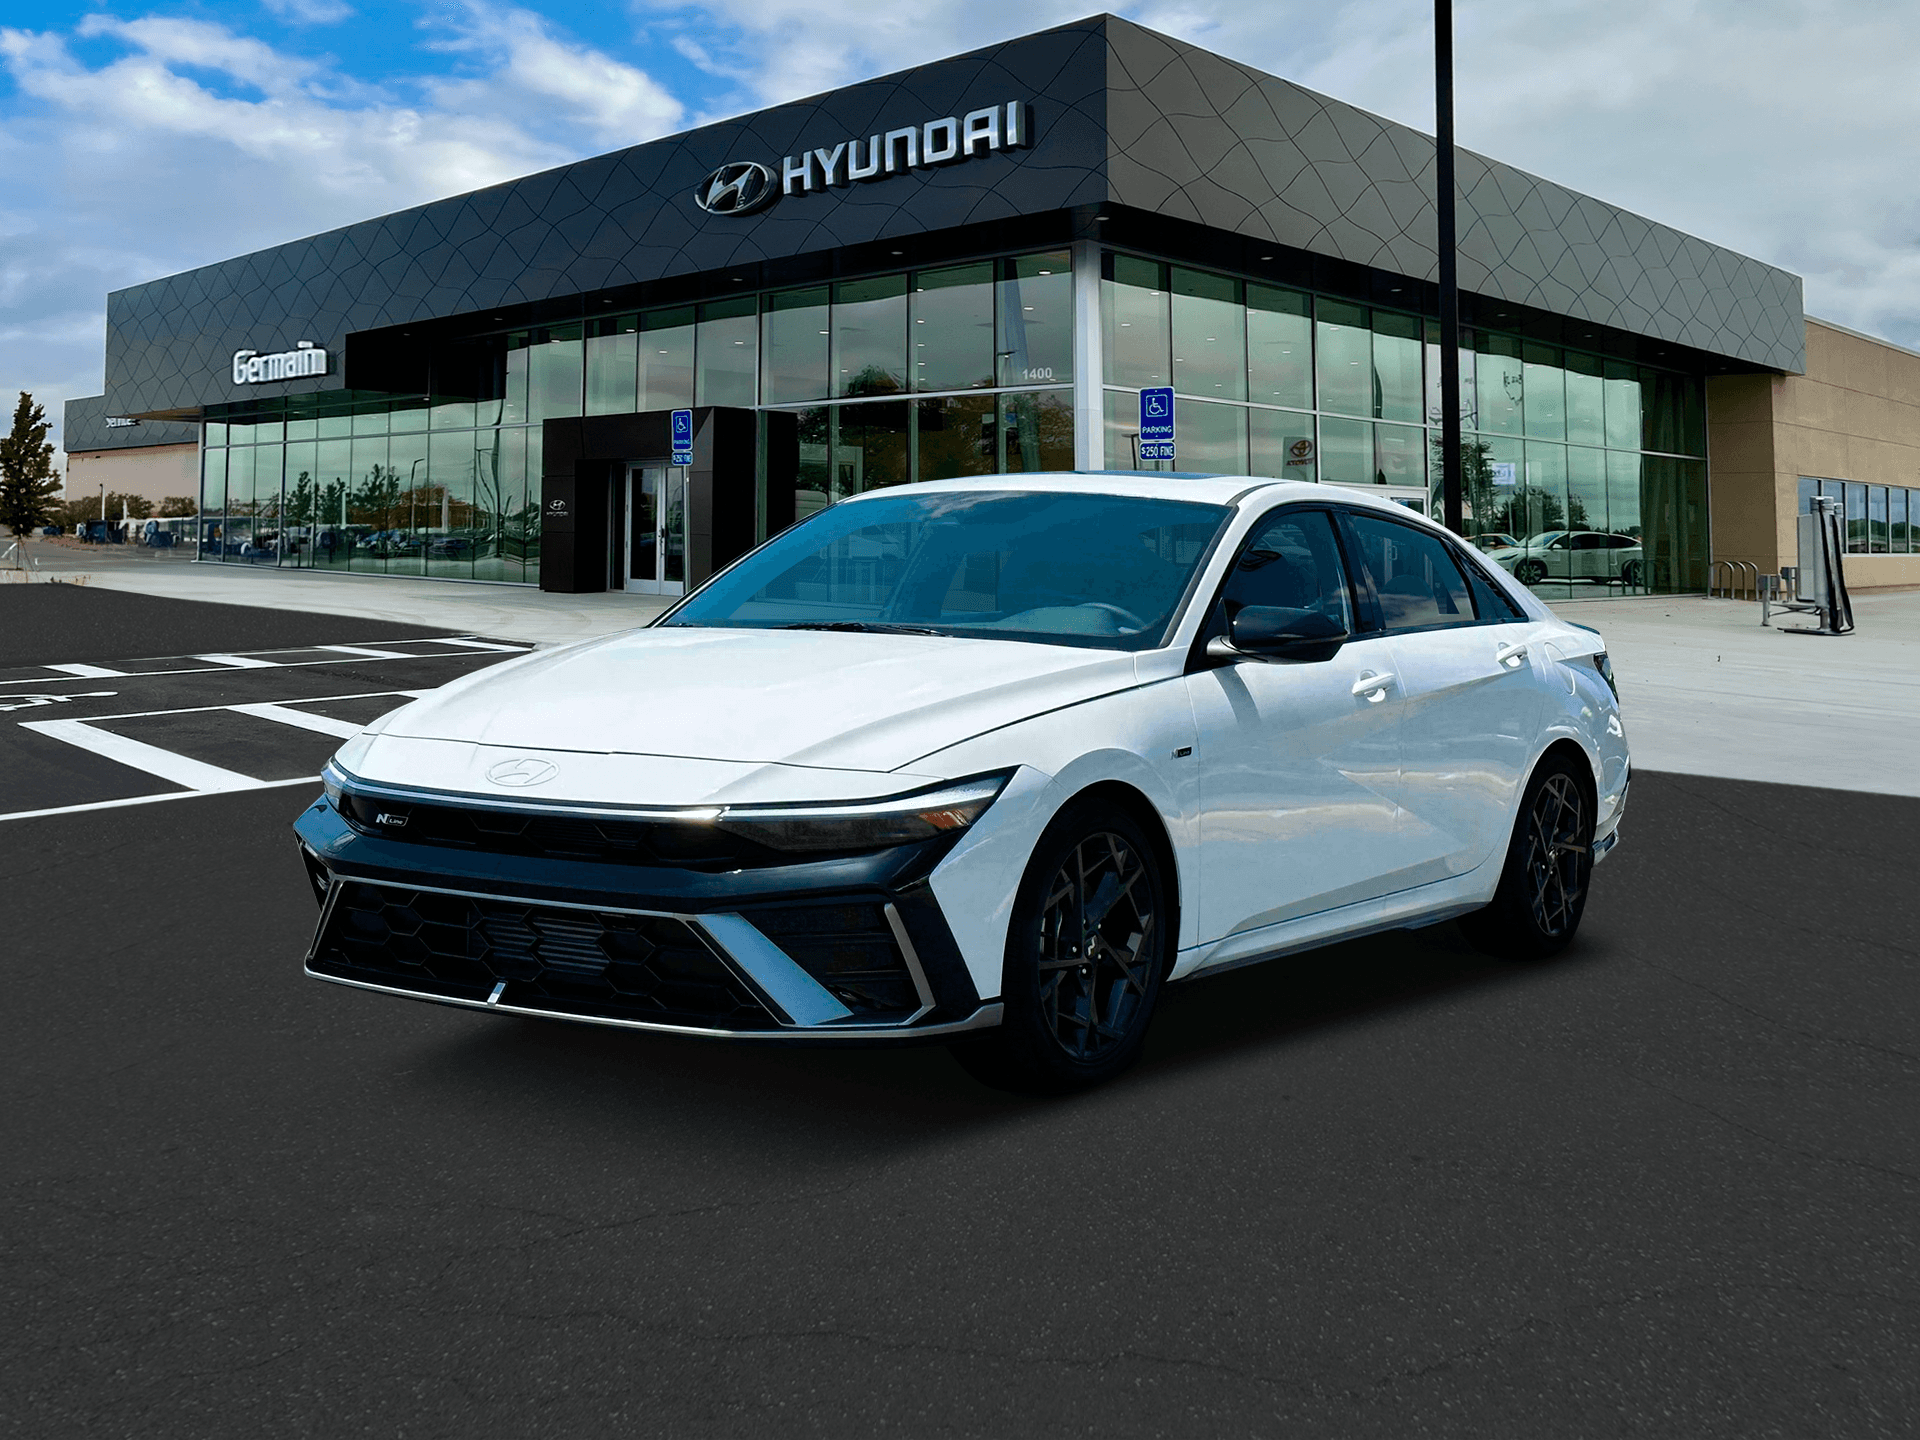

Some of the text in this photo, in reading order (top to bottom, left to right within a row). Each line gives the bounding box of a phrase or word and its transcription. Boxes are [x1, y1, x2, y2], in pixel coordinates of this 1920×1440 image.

[782, 100, 1022, 196] HYUNDAI
[233, 341, 327, 384] Germain
[1022, 367, 1052, 380] 1400
[1141, 425, 1172, 433] PARKING
[1141, 446, 1173, 456] $250 FINE
[376, 813, 389, 824] N
